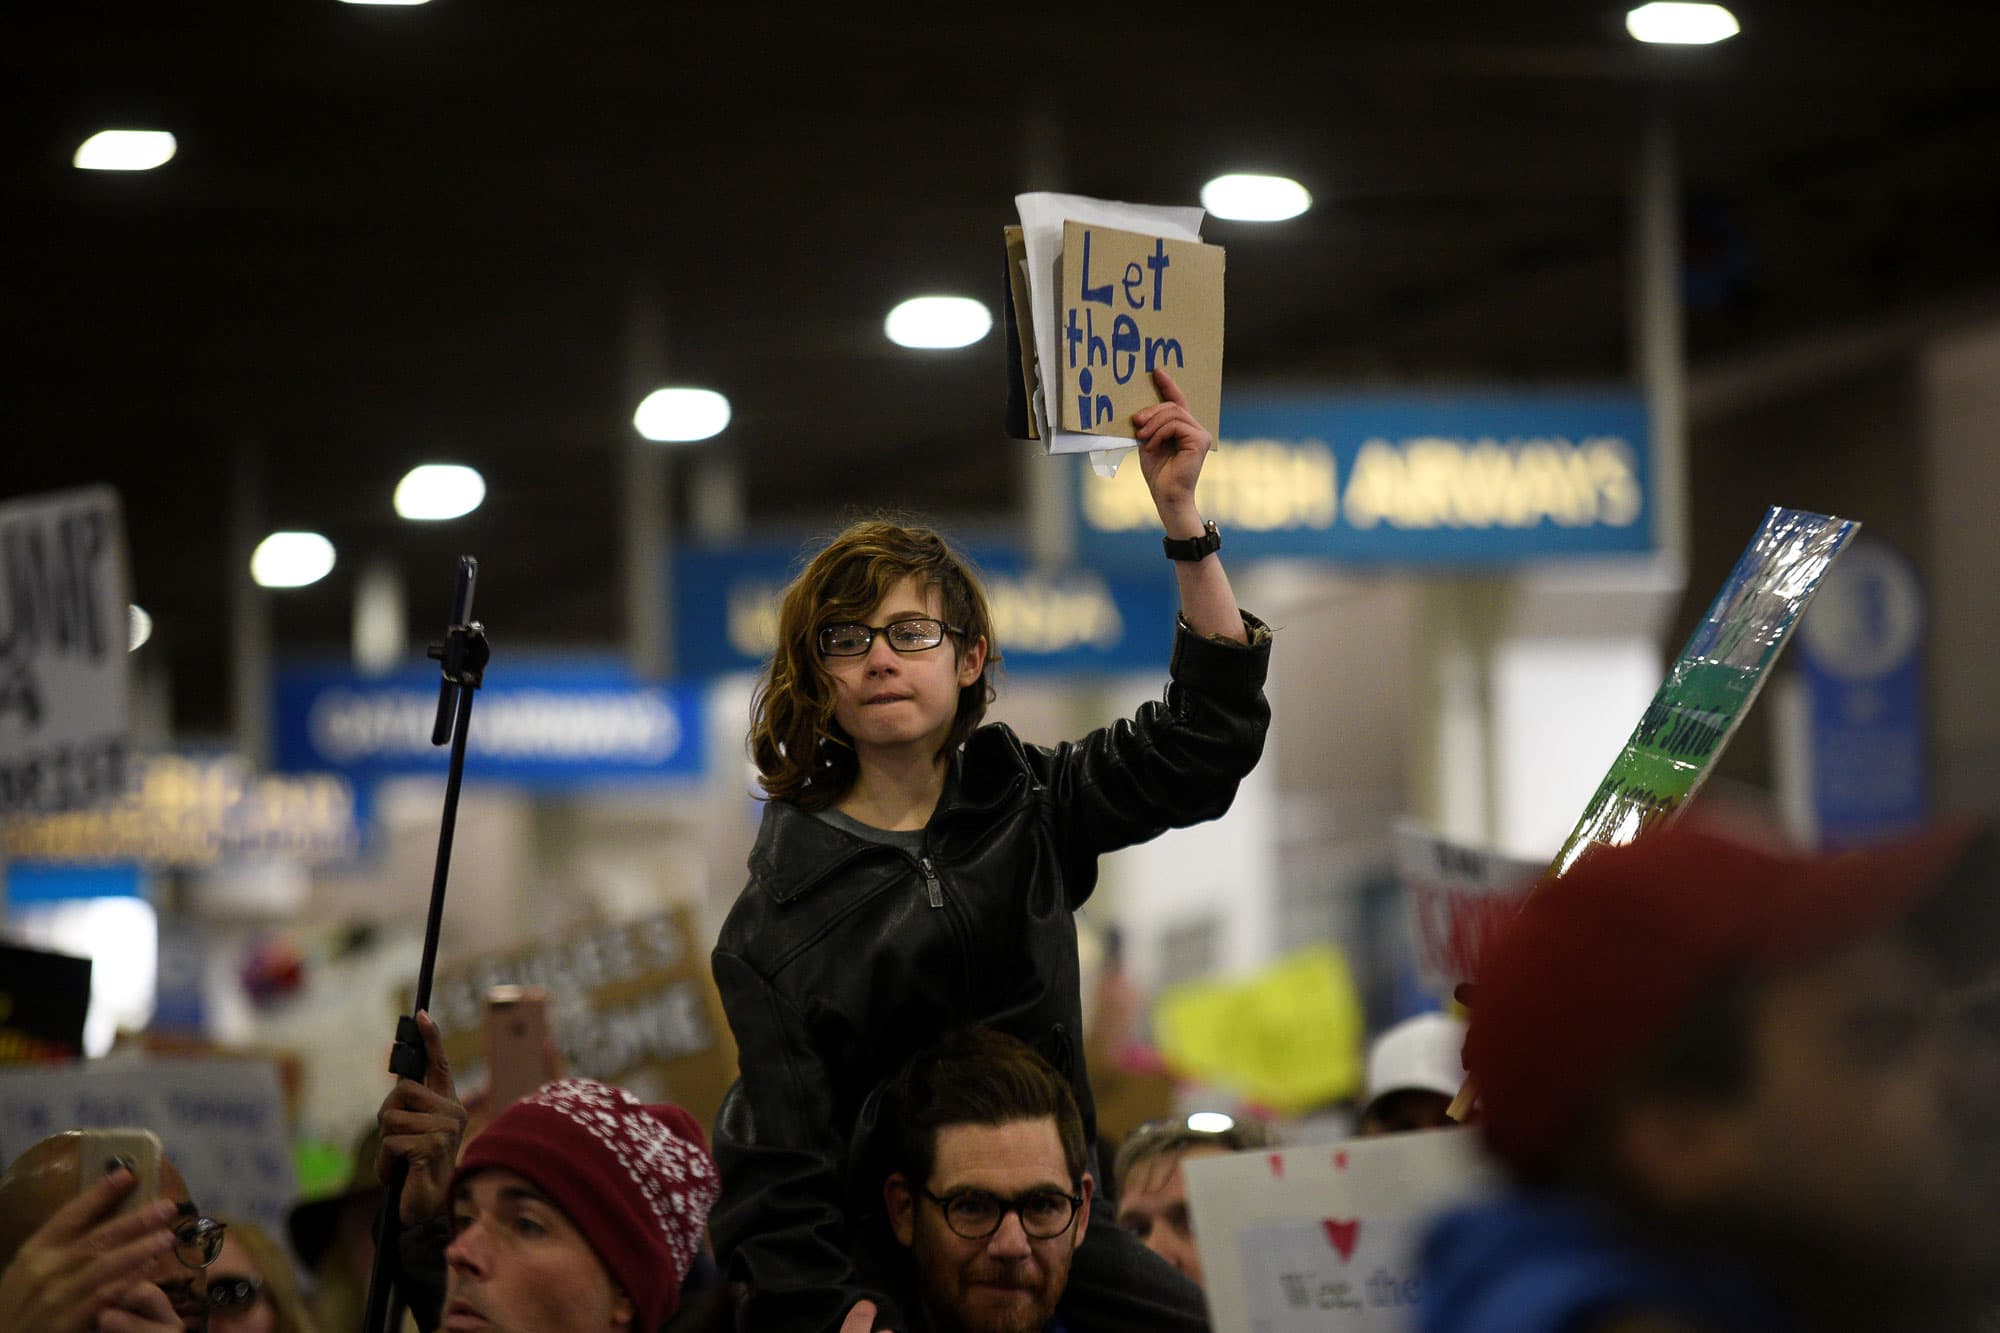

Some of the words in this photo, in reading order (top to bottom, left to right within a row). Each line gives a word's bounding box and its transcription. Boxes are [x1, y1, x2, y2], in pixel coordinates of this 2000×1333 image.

[1081, 230, 1170, 311] Let
[1066, 308, 1184, 384] them
[1078, 367, 1113, 430] in
[1344, 436, 1641, 528] AIRWAYS
